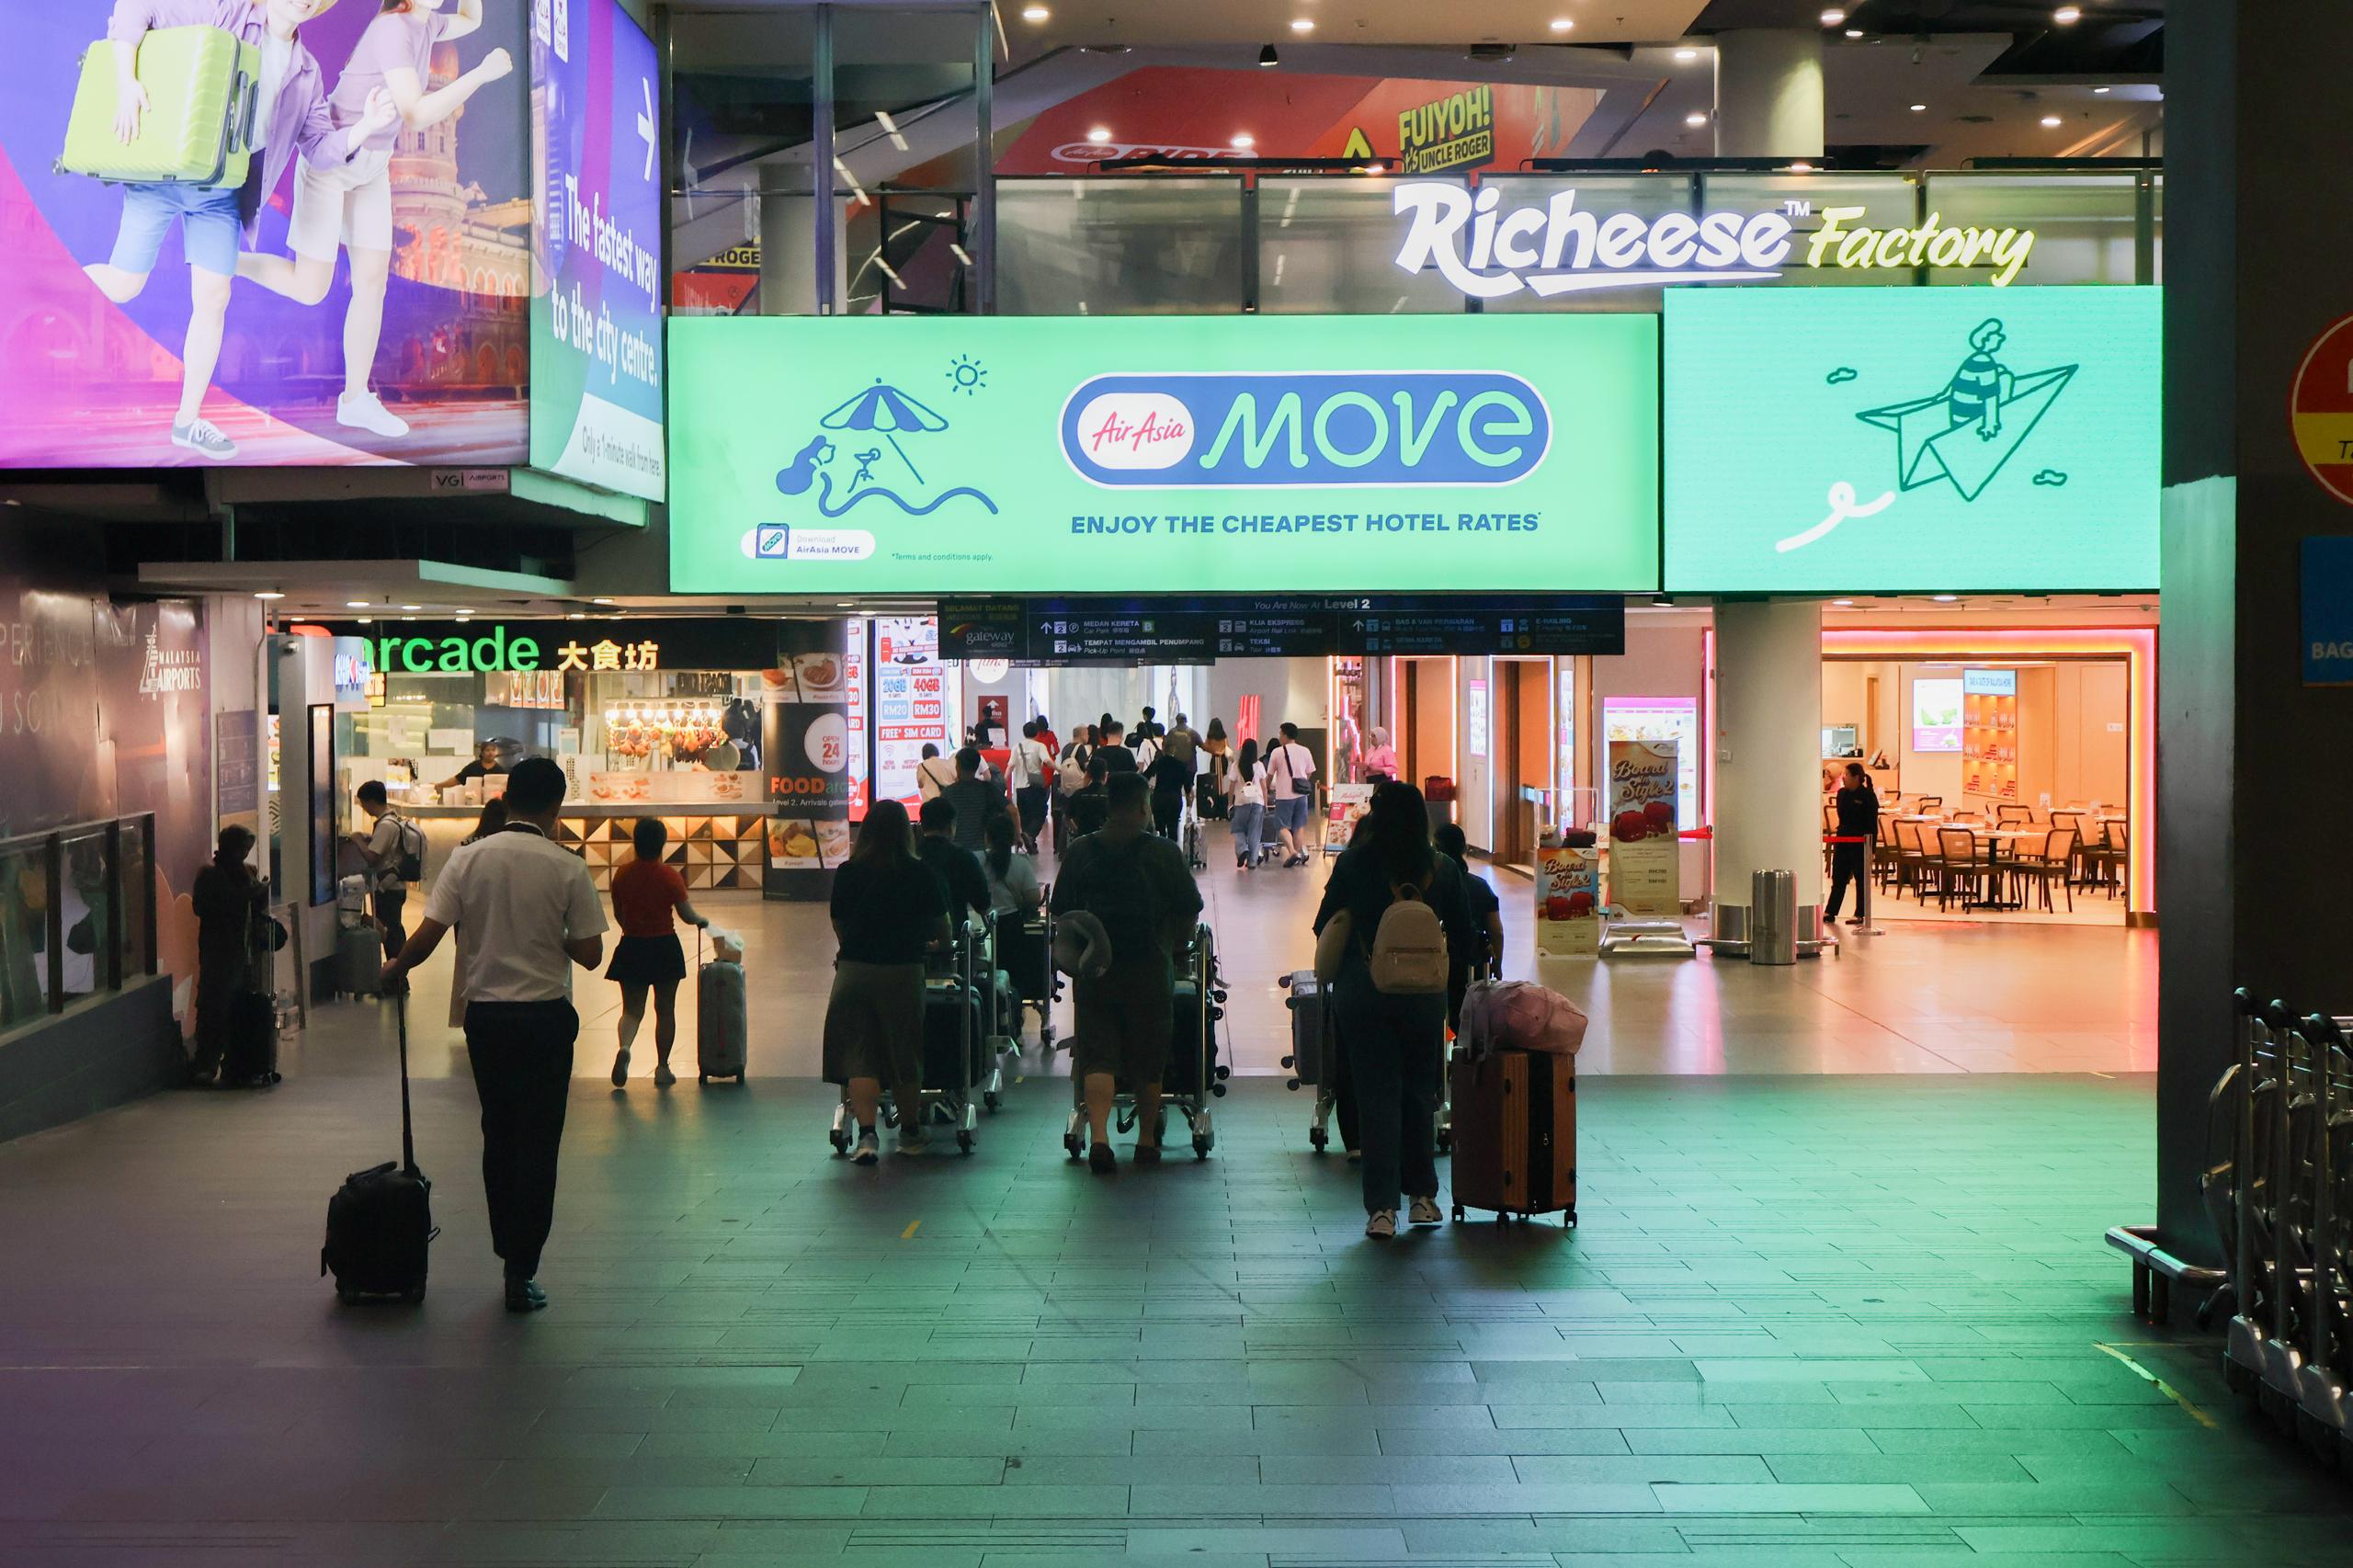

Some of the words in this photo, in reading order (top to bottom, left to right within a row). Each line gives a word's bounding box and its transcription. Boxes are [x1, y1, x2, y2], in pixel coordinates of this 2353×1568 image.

[1399, 84, 1491, 151] FUIYOH!
[1421, 144, 1453, 170] UNCLE
[1454, 135, 1489, 161] ROGER
[565, 173, 591, 252] The
[593, 191, 634, 282] fastest
[635, 245, 657, 313] way
[1394, 181, 1792, 298] Richeese
[1807, 207, 2037, 287] Factory
[551, 278, 568, 343] to
[571, 281, 594, 355] the
[597, 300, 619, 385] city
[621, 330, 658, 388] centre.
[582, 426, 596, 464] Only
[1071, 516, 1158, 534] ENJOY
[1165, 515, 1214, 533] THE
[1222, 514, 1356, 533] CHEAPEST
[1366, 513, 1449, 532] HOTEL
[796, 535, 836, 543] Download
[1255, 601, 1271, 610] You
[1272, 601, 1288, 610] Are
[1290, 601, 1308, 610] Now
[1324, 598, 1358, 609] Level
[1361, 599, 1371, 609] 2
[1143, 621, 1153, 631] B
[966, 631, 1015, 645] gateway
[158, 650, 201, 665] MALAYSIA
[556, 639, 659, 671] 大食坊
[157, 666, 201, 691] AIRPORTS
[914, 678, 939, 692] 40GB
[883, 704, 907, 715] RM20
[914, 703, 940, 715] RM30
[904, 727, 918, 738] SIM
[920, 727, 942, 737] CARD
[822, 743, 840, 758] 24
[1613, 760, 1668, 782] Board
[1622, 779, 1664, 804] Style
[1544, 858, 1587, 875] Board
[1551, 872, 1583, 892] Style
